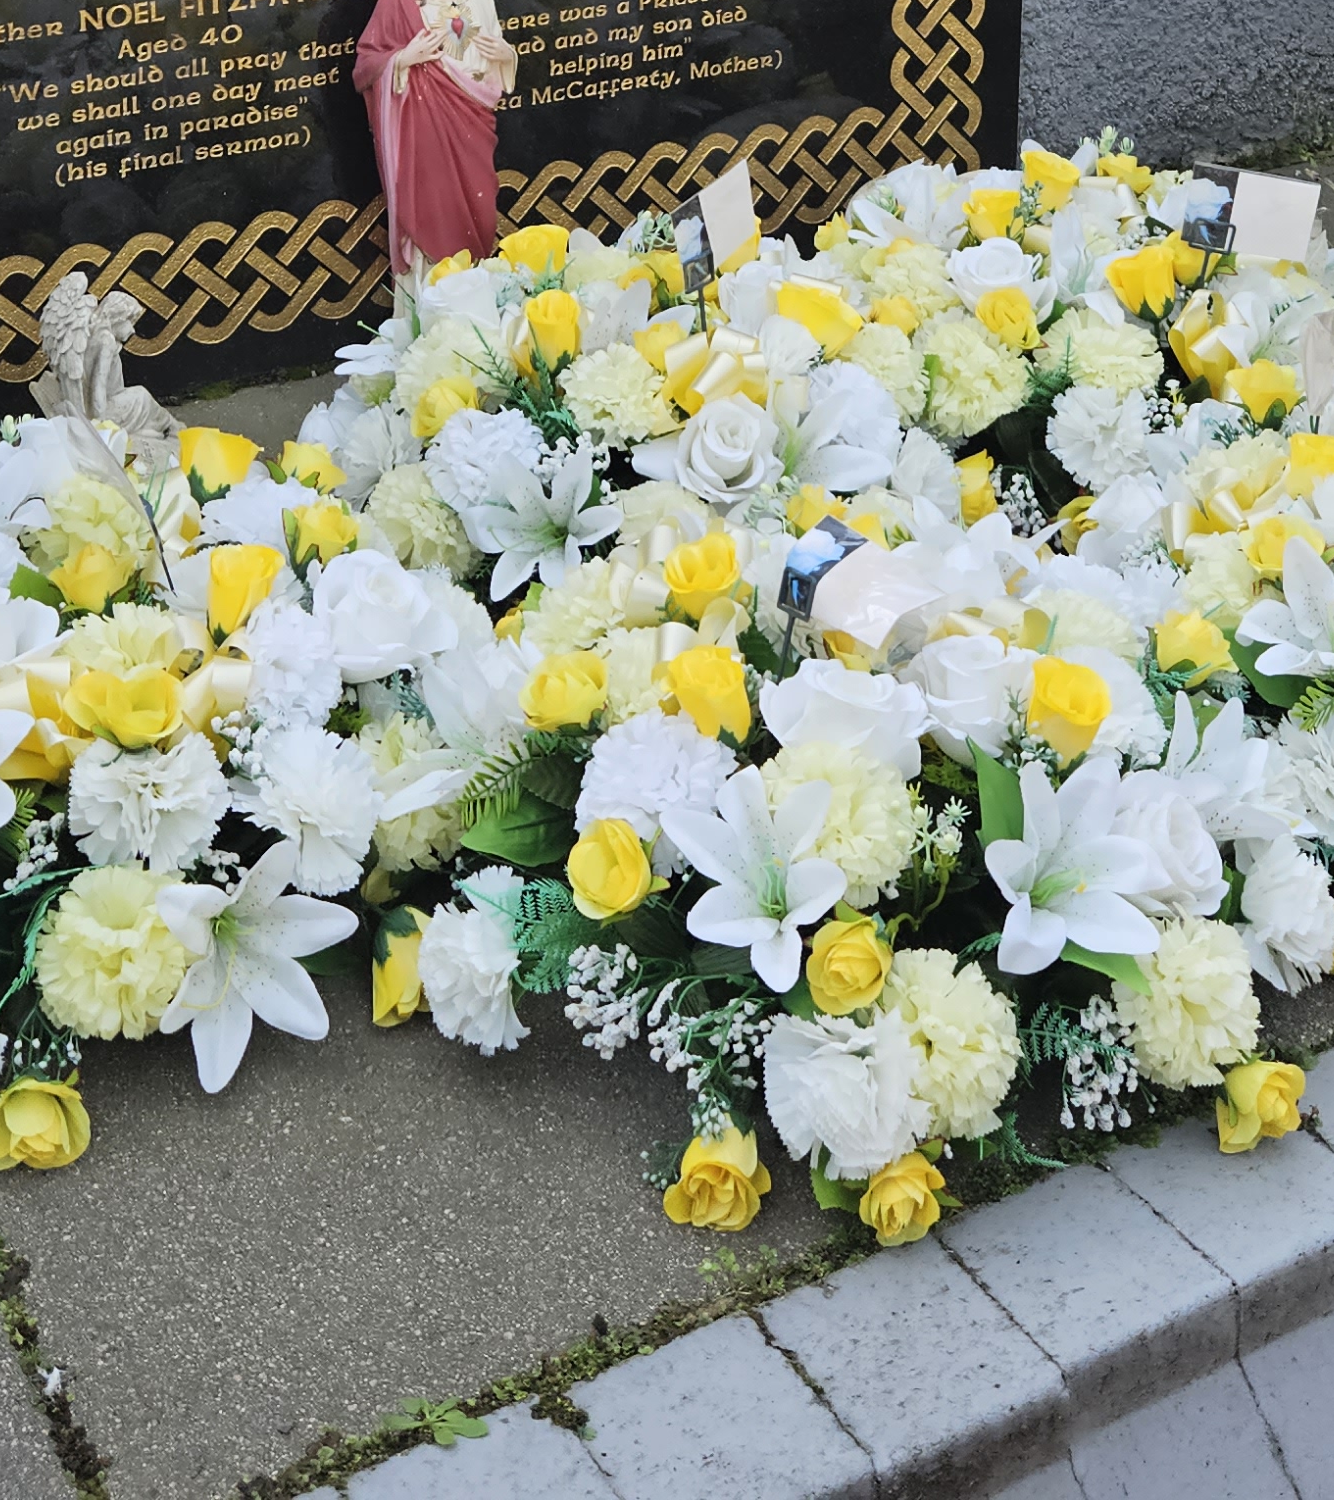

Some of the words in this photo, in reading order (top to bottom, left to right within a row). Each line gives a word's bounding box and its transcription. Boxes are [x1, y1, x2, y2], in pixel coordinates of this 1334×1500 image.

[78, 0, 166, 32] NOEL
[554, 27, 599, 50] and
[607, 24, 644, 44] my
[652, 17, 693, 35] son
[701, 5, 748, 28] died
[559, 4, 608, 23] was
[616, 0, 630, 15] a
[117, 33, 188, 63] Aged
[199, 24, 243, 46] 40
[549, 51, 634, 77] helping
[70, 64, 164, 95] should
[174, 56, 210, 80] all
[220, 50, 287, 79] pray
[297, 37, 355, 62] that
[531, 68, 681, 102] McCafferty,
[689, 49, 783, 80] Mother)
[17, 112, 61, 132] we
[71, 95, 141, 123] shall
[151, 91, 202, 112] one
[211, 81, 262, 103] day
[274, 66, 339, 93] meet
[55, 126, 132, 158] again
[143, 123, 169, 141] in
[55, 160, 108, 188] (his
[118, 145, 184, 179] final
[195, 125, 312, 162] sermon)
